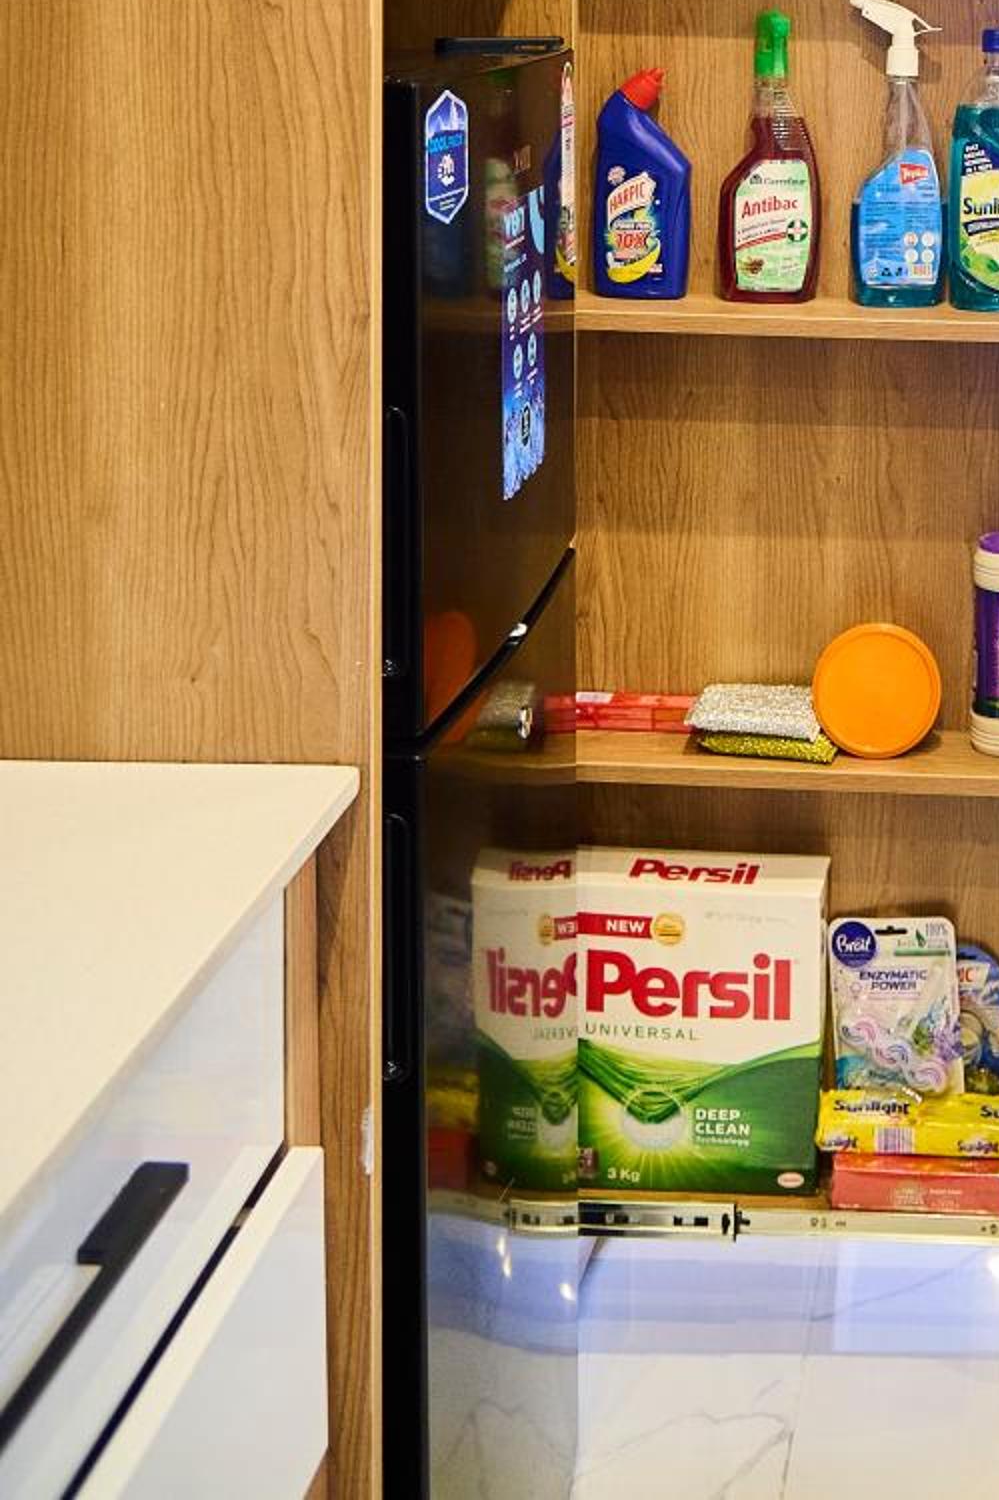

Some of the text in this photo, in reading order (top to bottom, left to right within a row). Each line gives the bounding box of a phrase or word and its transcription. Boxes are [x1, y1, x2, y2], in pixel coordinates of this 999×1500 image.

[609, 181, 646, 214] HARPIC
[741, 196, 798, 219] Antibac
[629, 858, 761, 885] Persil
[606, 918, 645, 933] NEW
[859, 968, 928, 982] ENZYMATIC
[585, 948, 791, 1021] Persil
[870, 980, 918, 992] POWER
[585, 1023, 698, 1041] UNIVERSAL
[833, 1100, 910, 1115] Sunlight
[695, 1109, 741, 1122] DEEP
[695, 1124, 750, 1137] CLEAN
[607, 1169, 641, 1183] 3 Kg
